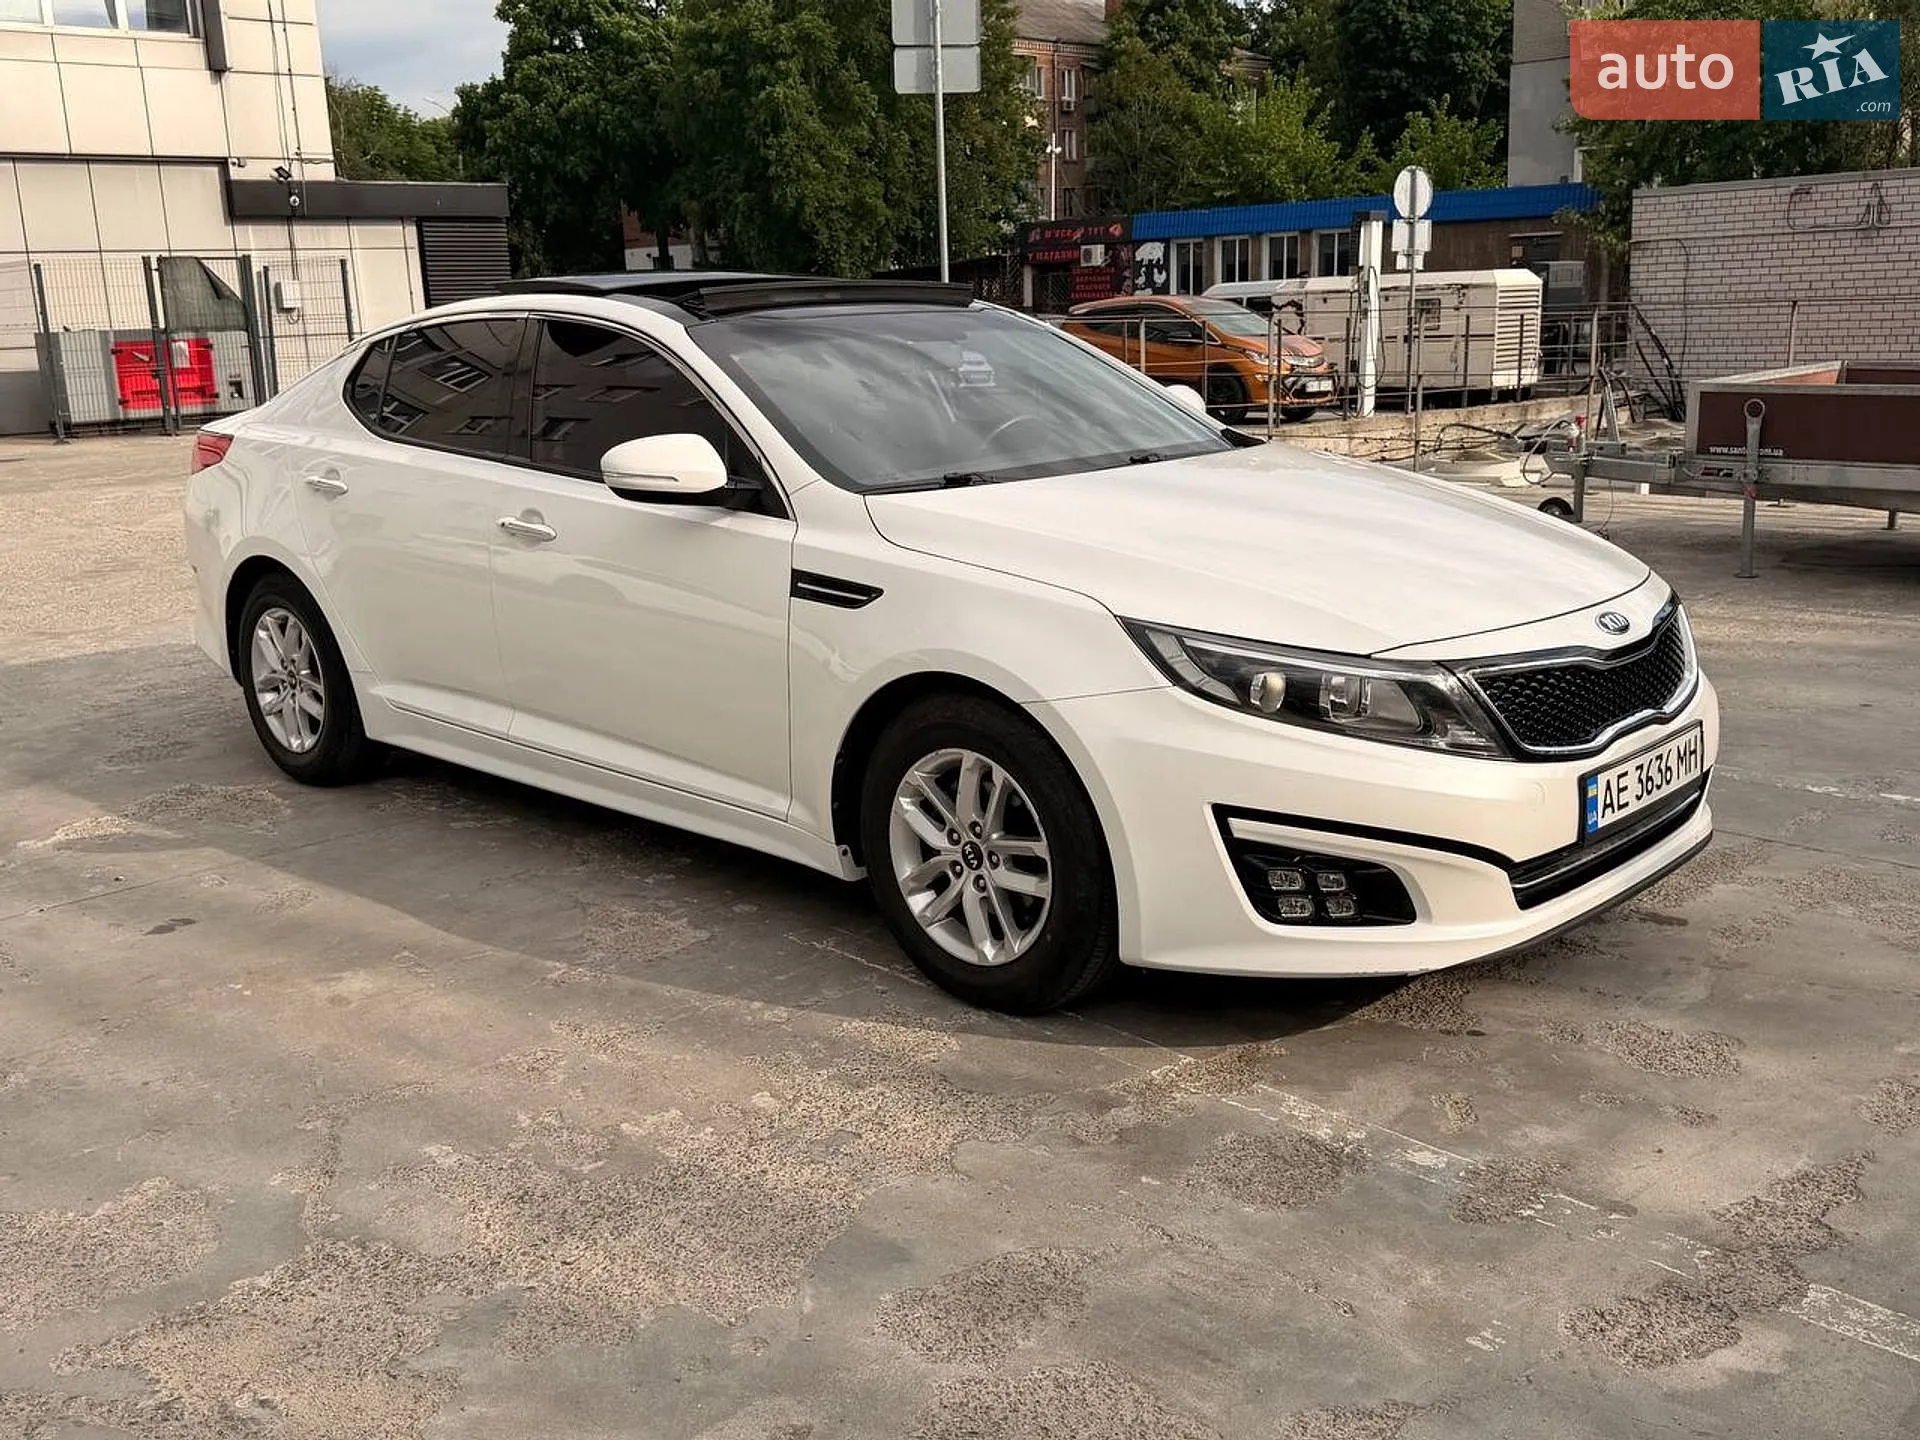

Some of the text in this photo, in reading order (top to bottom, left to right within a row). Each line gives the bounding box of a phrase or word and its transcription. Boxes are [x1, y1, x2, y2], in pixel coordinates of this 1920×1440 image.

[1600, 613, 1629, 631] KIA
[1601, 734, 1698, 819] AE 3636 MH
[964, 844, 978, 869] KIA
